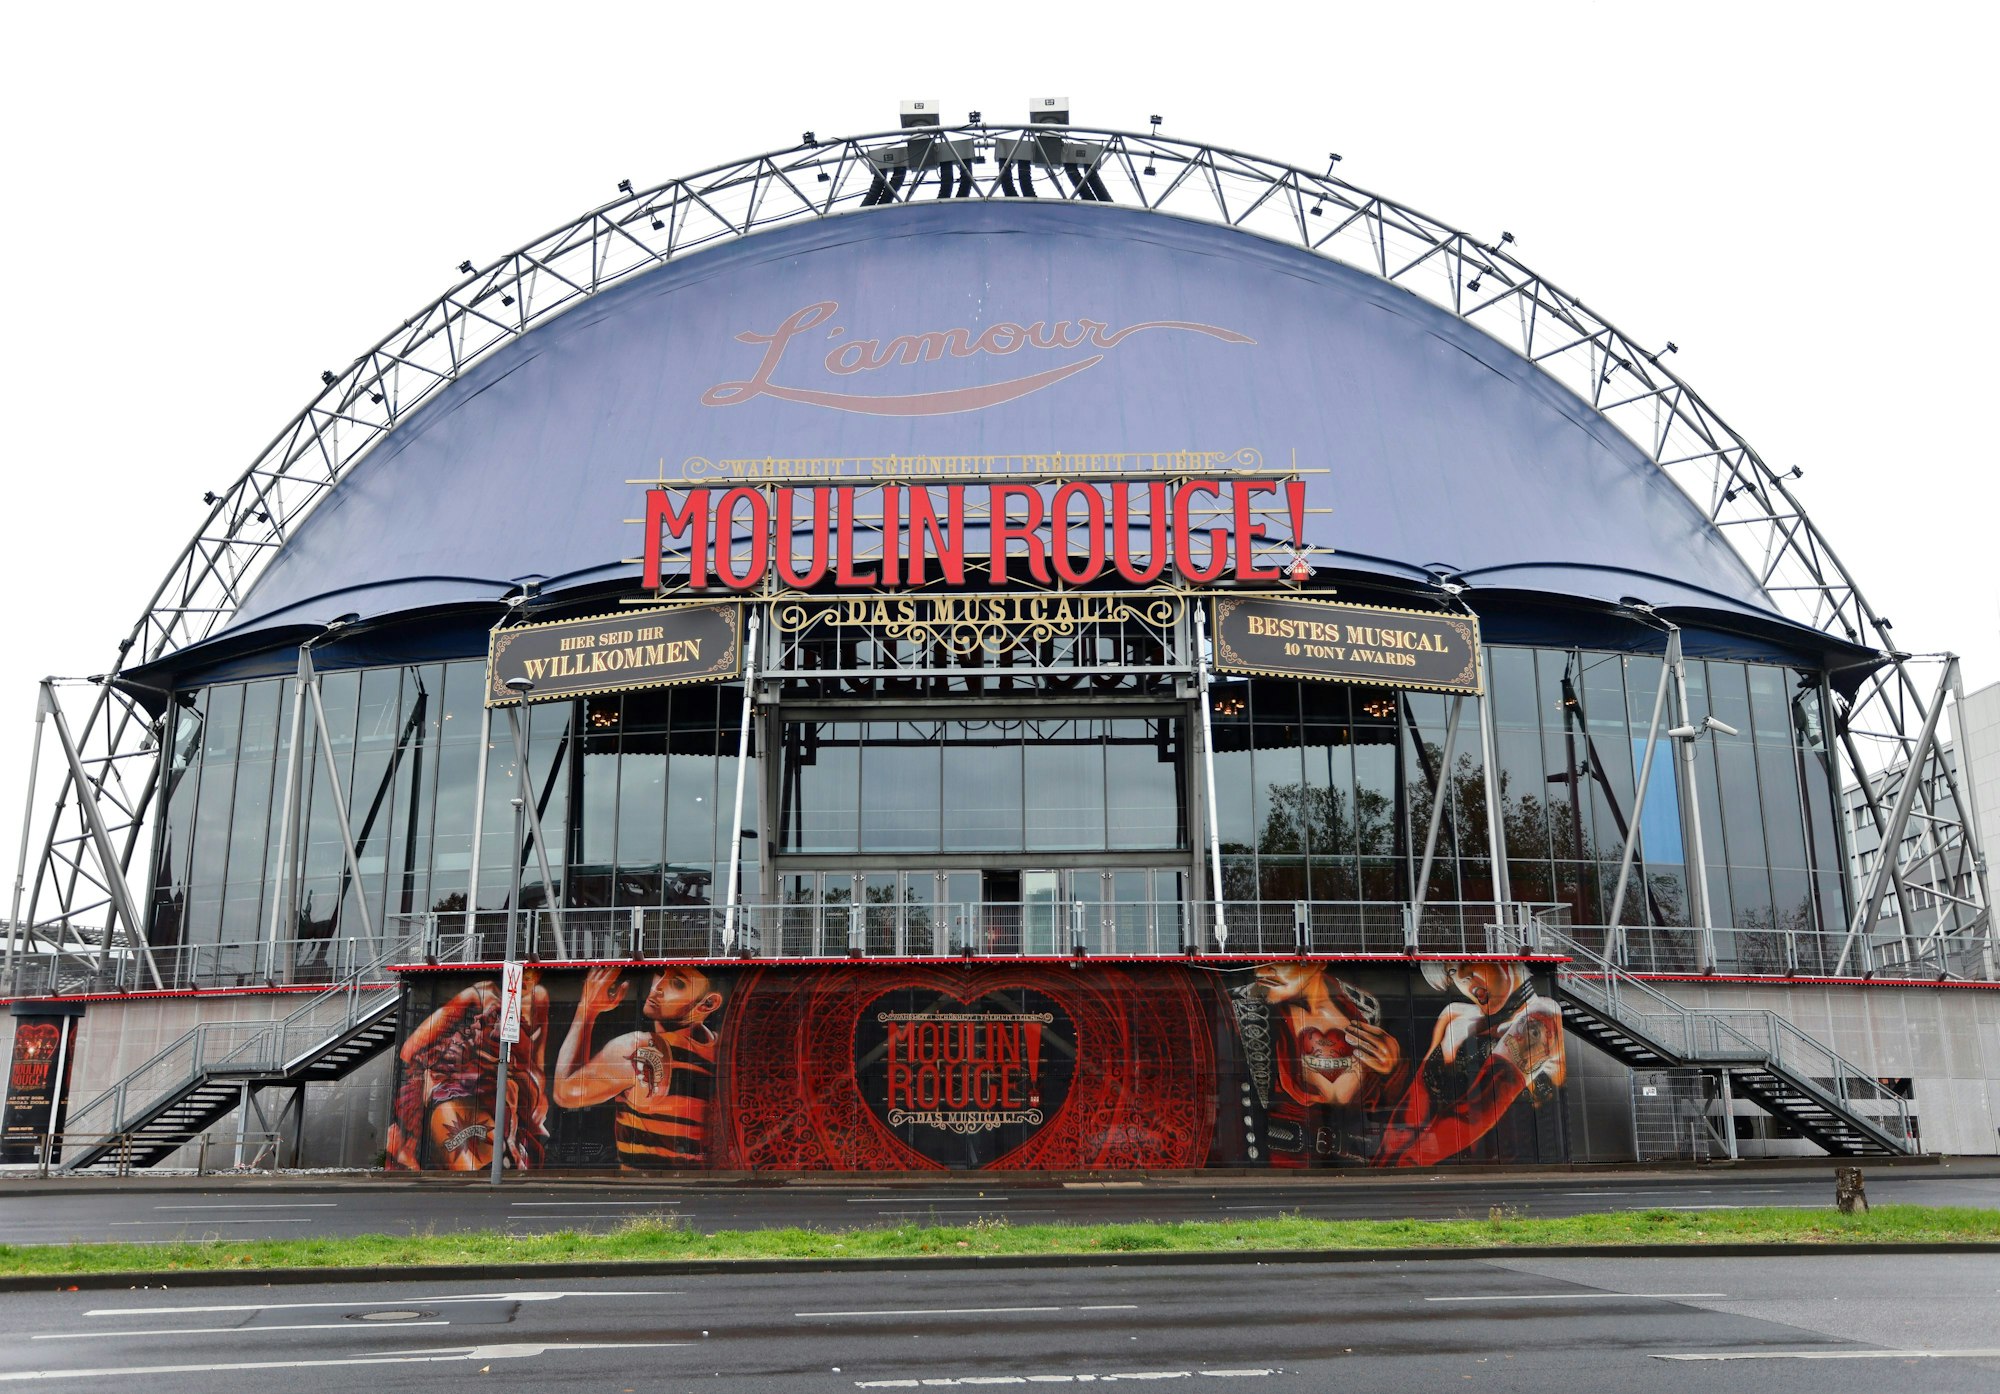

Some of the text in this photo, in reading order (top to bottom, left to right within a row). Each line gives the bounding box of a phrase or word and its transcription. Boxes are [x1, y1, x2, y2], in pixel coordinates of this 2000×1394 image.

[701, 301, 1257, 416] L'amour
[727, 451, 1216, 477] WAHRHEIT SCHÖNHEIT FREIHEIT LIEBE
[642, 486, 966, 590] MOULIN
[846, 597, 1115, 623] DAS MUSICAL!
[559, 625, 665, 651] HIER SEID IHR
[1246, 615, 1449, 653] BESTES MUSICAL
[523, 638, 703, 680] WILLKOMMEN
[1283, 641, 1417, 667] 10 TONY AWARDS
[887, 1021, 1021, 1064] MOULIN
[639, 1049, 664, 1079] FREIHEIT
[1309, 1057, 1349, 1069] LIEBE
[917, 1112, 943, 1124] DAS
